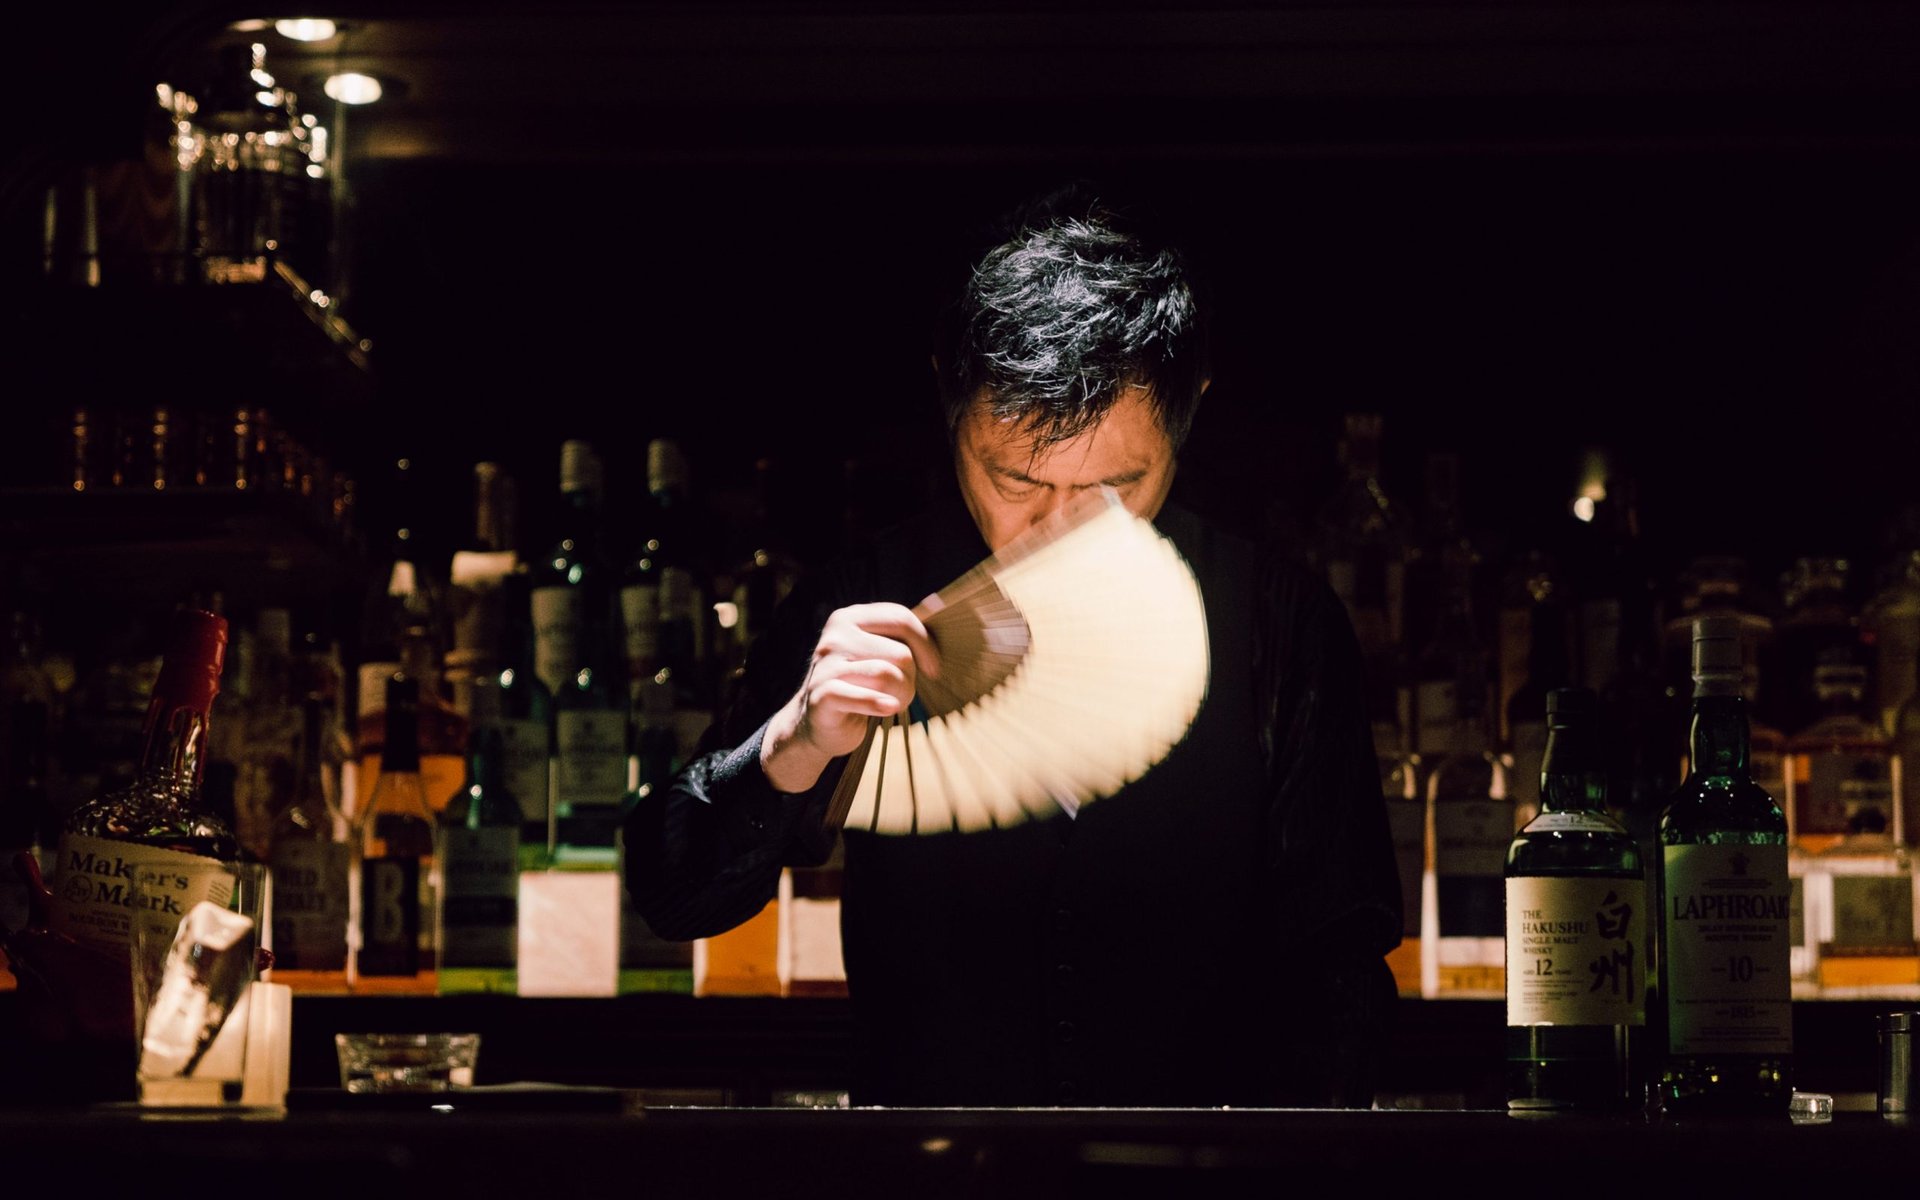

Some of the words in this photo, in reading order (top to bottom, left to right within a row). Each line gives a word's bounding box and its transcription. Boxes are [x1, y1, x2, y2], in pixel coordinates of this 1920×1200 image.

[1522, 910, 1542, 920] THE
[1522, 922, 1588, 934] HAKUSHU
[1522, 936, 1551, 945] SINGLE
[1553, 936, 1579, 945] MALT
[1589, 890, 1634, 1004] 白州
[1535, 958, 1553, 976] 12
[1728, 955, 1754, 983] 10
